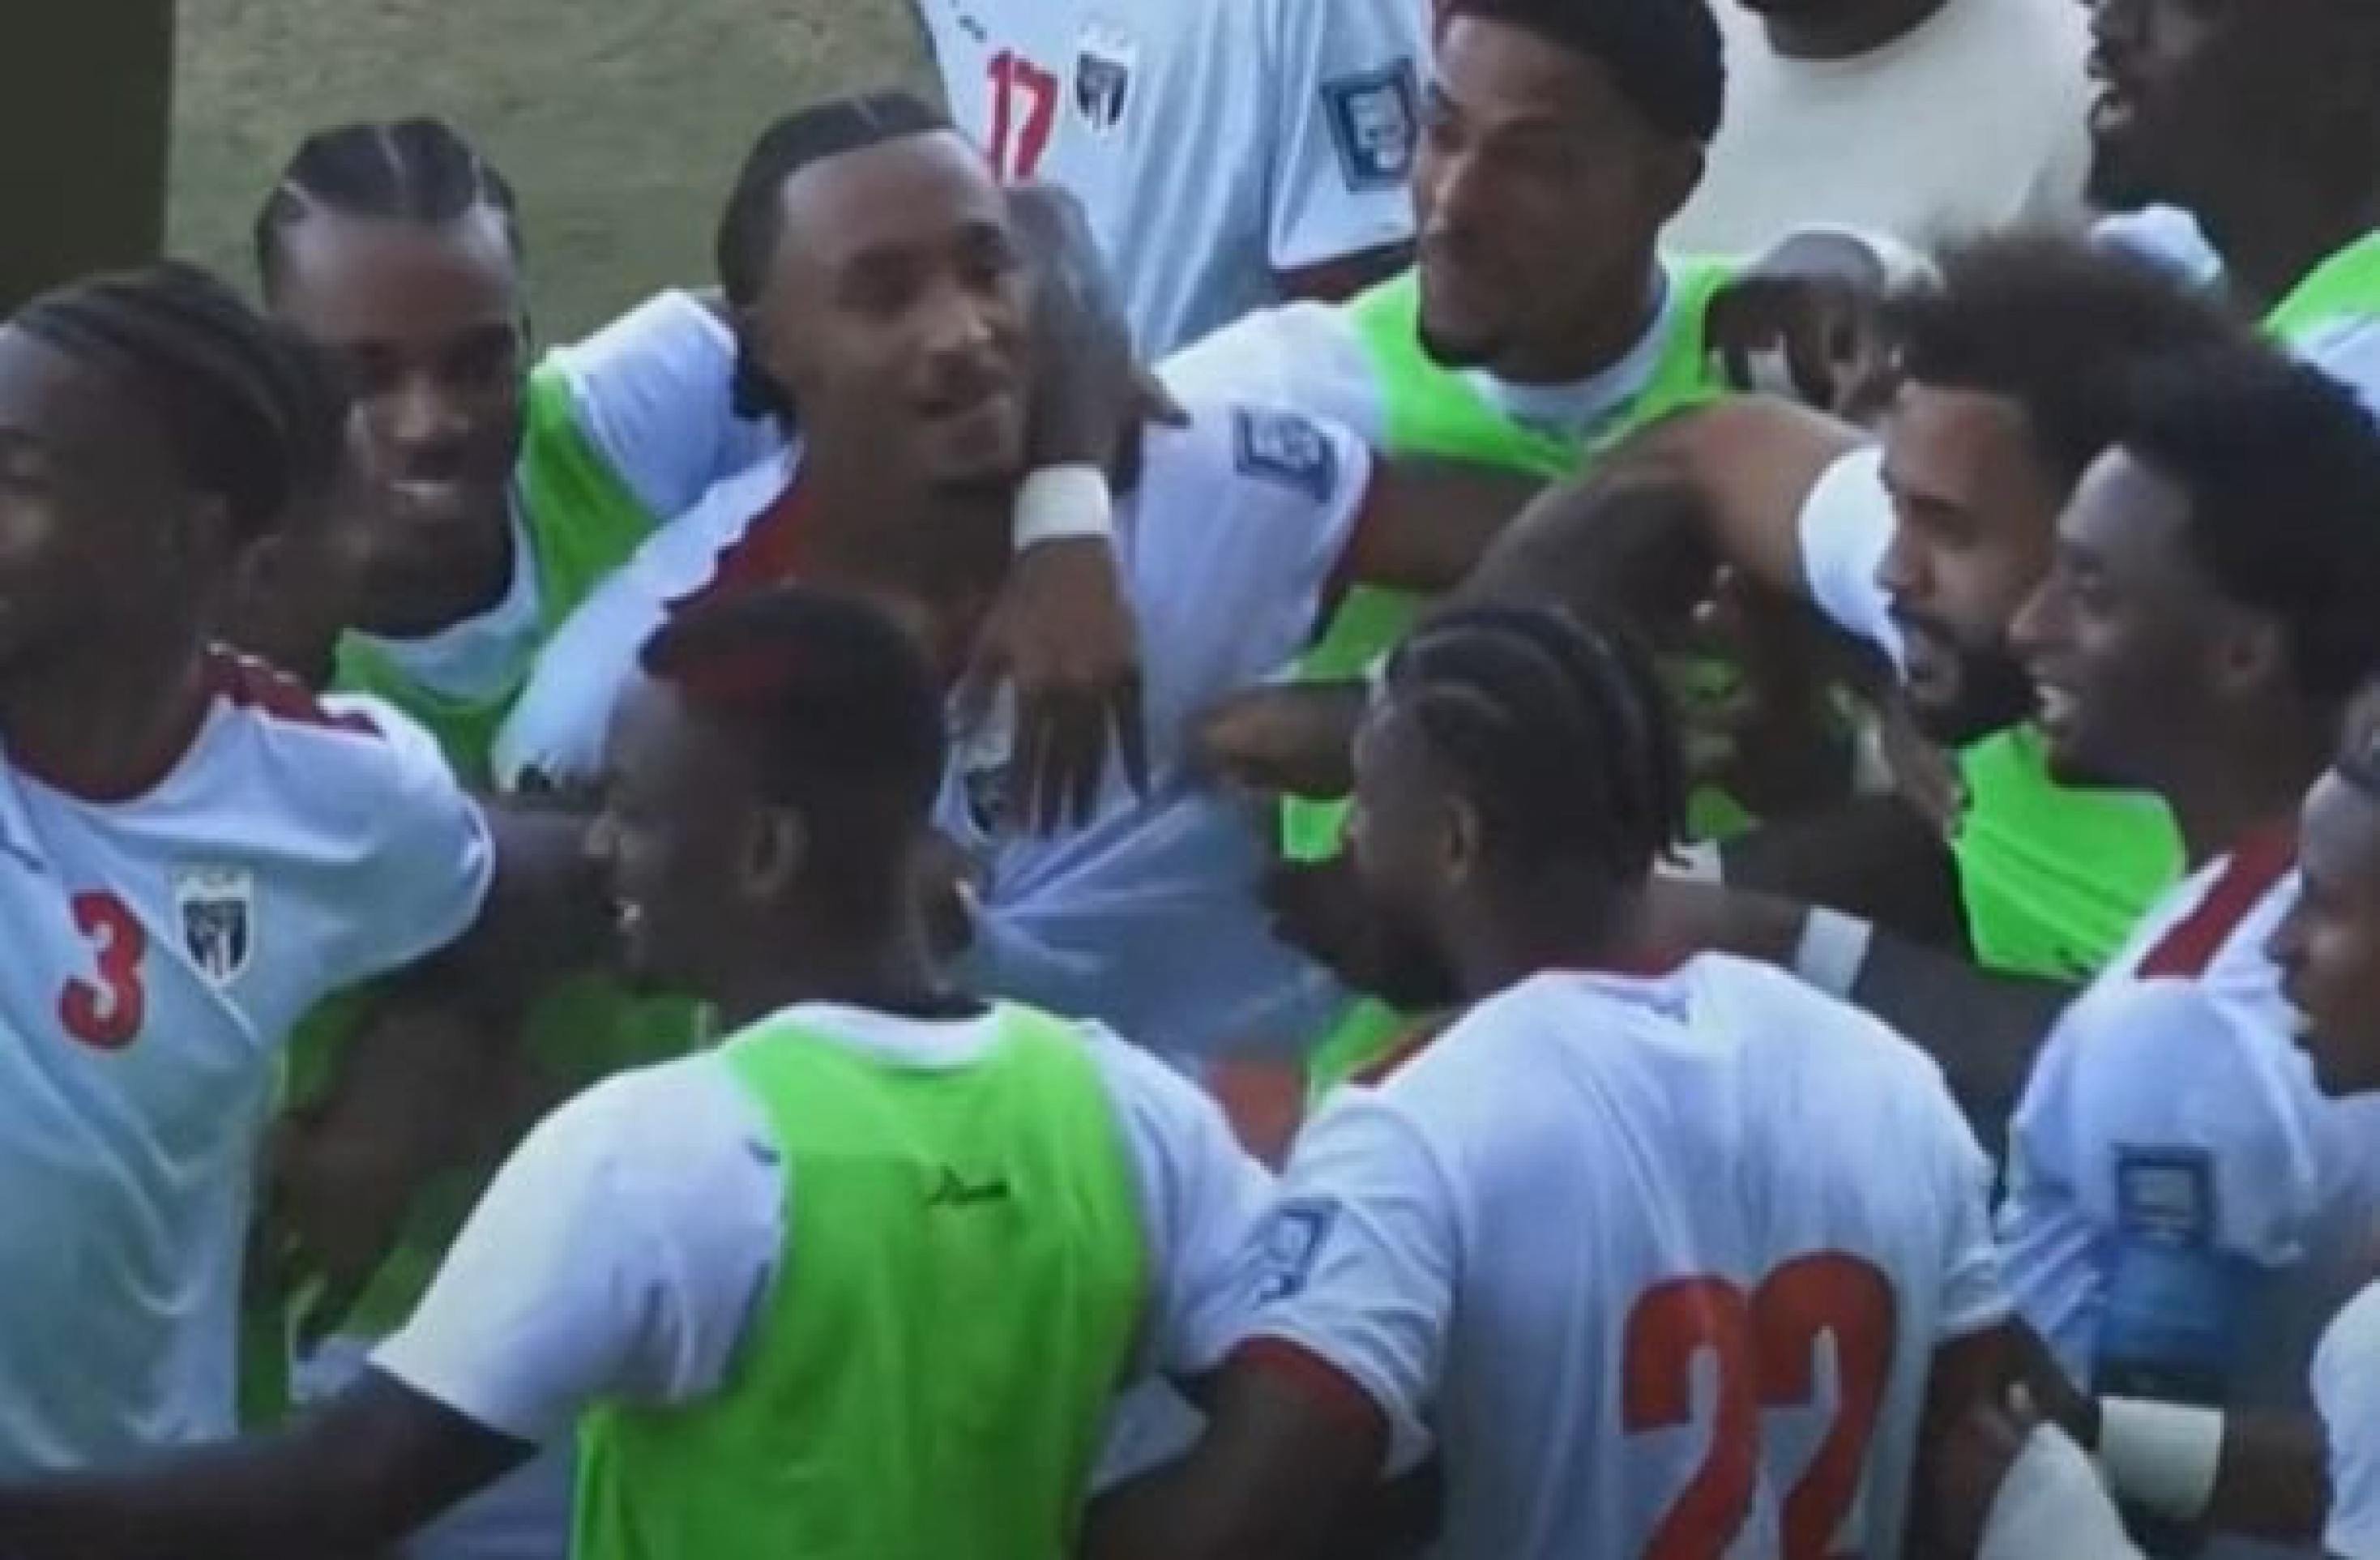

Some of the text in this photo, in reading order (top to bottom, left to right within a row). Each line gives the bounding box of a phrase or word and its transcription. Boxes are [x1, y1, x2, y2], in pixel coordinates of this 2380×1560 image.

[986, 48, 1058, 186] 17
[59, 890, 147, 1049] 3
[1622, 1251, 1898, 1560] 22
